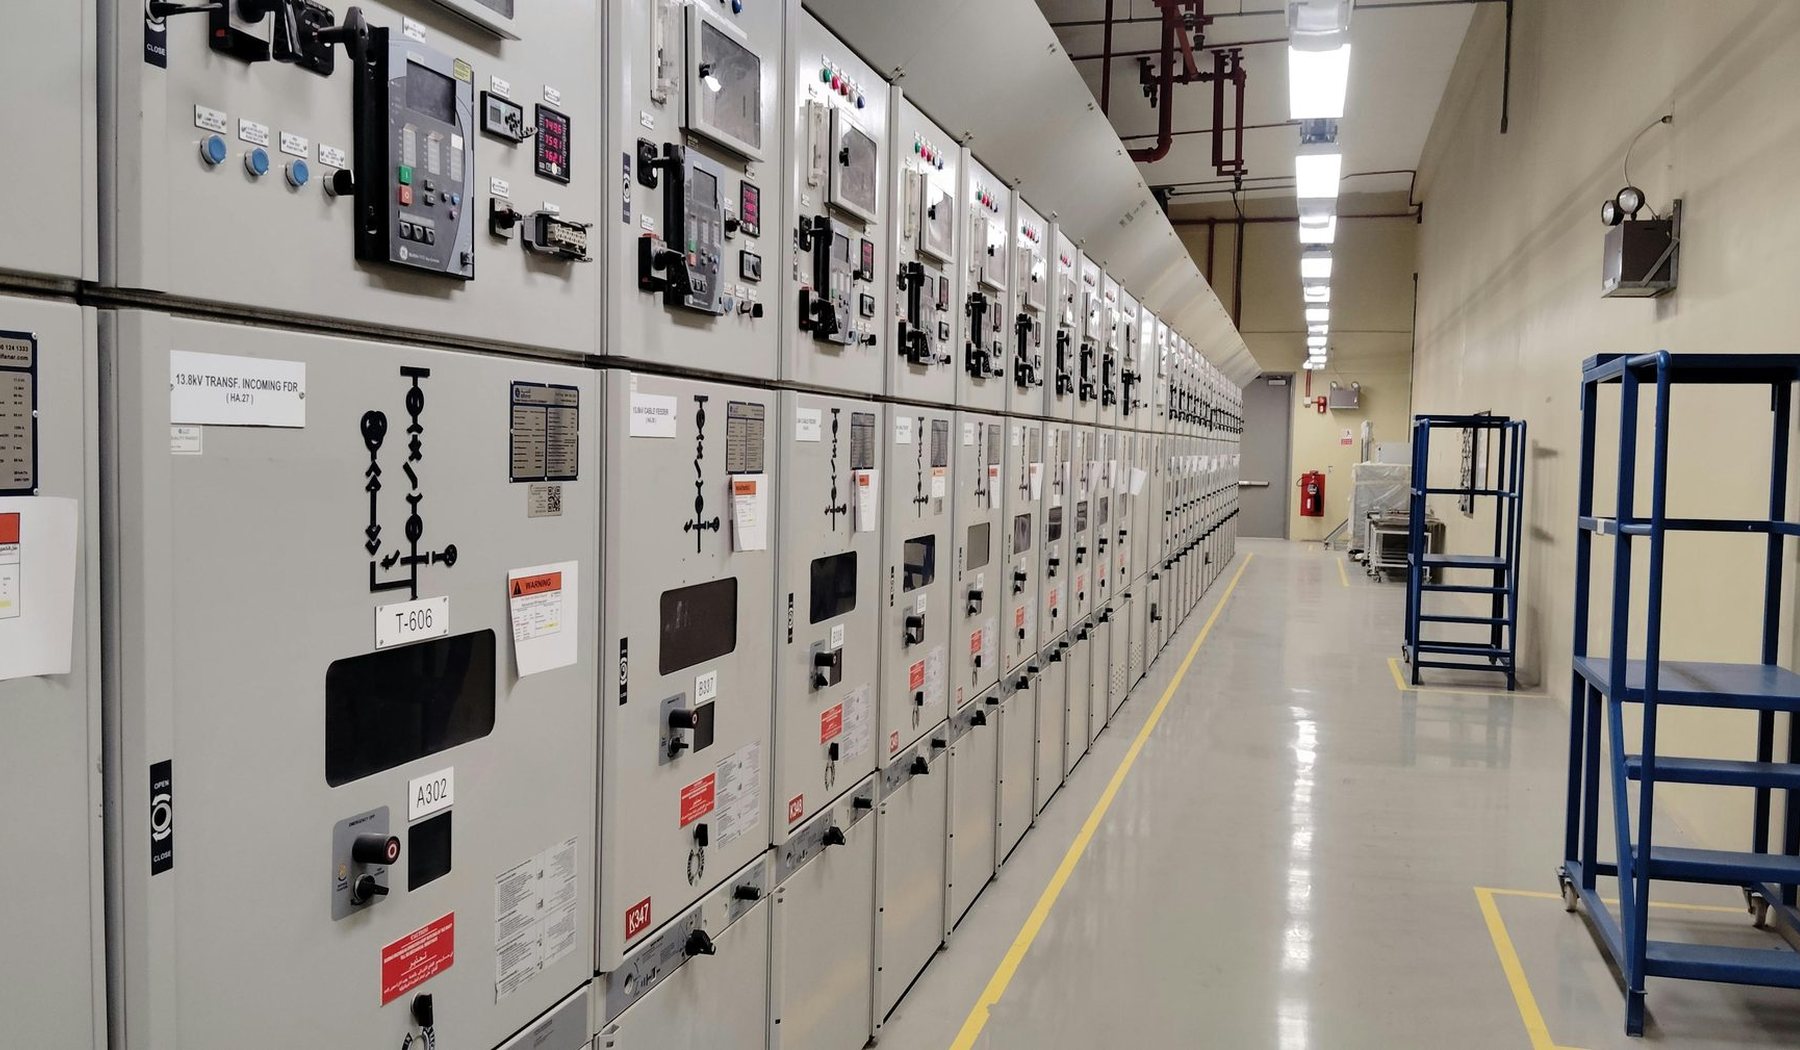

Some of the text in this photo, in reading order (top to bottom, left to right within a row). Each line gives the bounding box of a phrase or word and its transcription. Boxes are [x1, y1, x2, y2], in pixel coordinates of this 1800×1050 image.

[146, 43, 166, 56] CLOSE
[176, 373, 298, 392] 13.8kV TRANSF. INCOMING FDR
[525, 578, 552, 590] WARNING
[395, 608, 433, 633] T-606
[153, 779, 170, 790] OPEN
[416, 778, 447, 808] A302
[153, 850, 172, 863] CLOSE
[628, 903, 650, 934] K347
